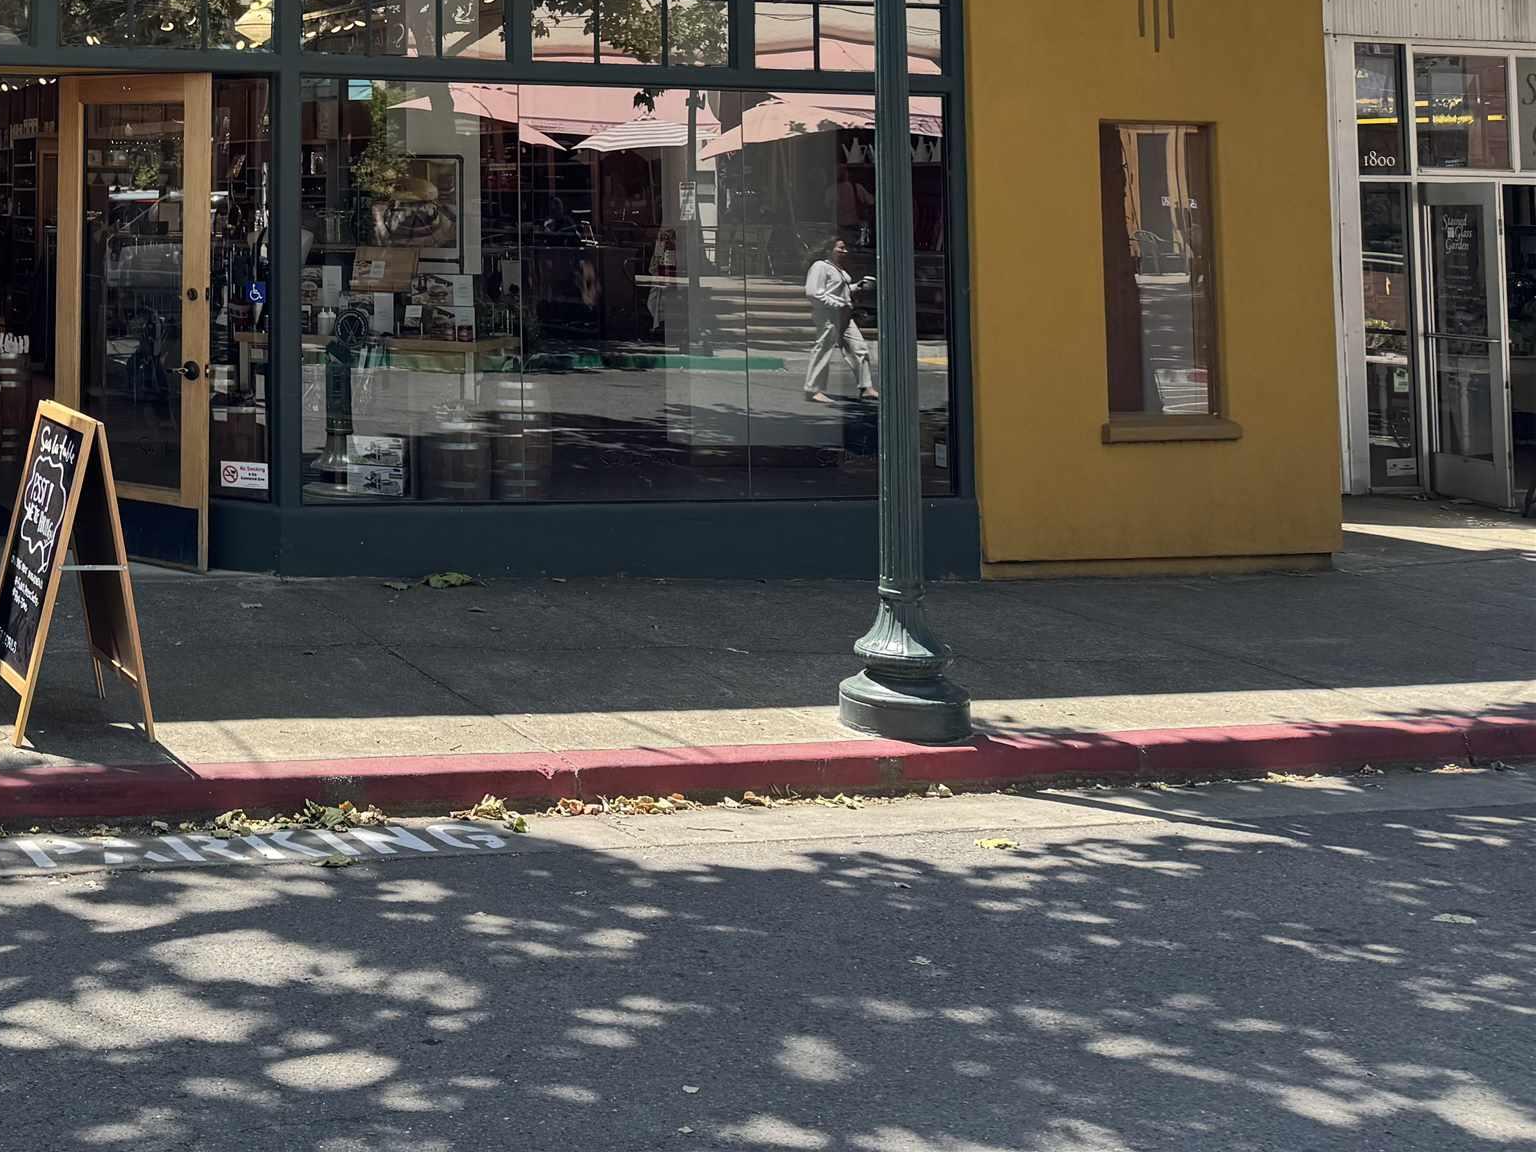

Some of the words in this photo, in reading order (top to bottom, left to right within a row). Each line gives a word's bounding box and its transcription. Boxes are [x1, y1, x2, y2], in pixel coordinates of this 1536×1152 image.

[1364, 150, 1396, 167] 1800
[1454, 226, 1473, 242] Glass
[15, 823, 508, 866] PARKING
